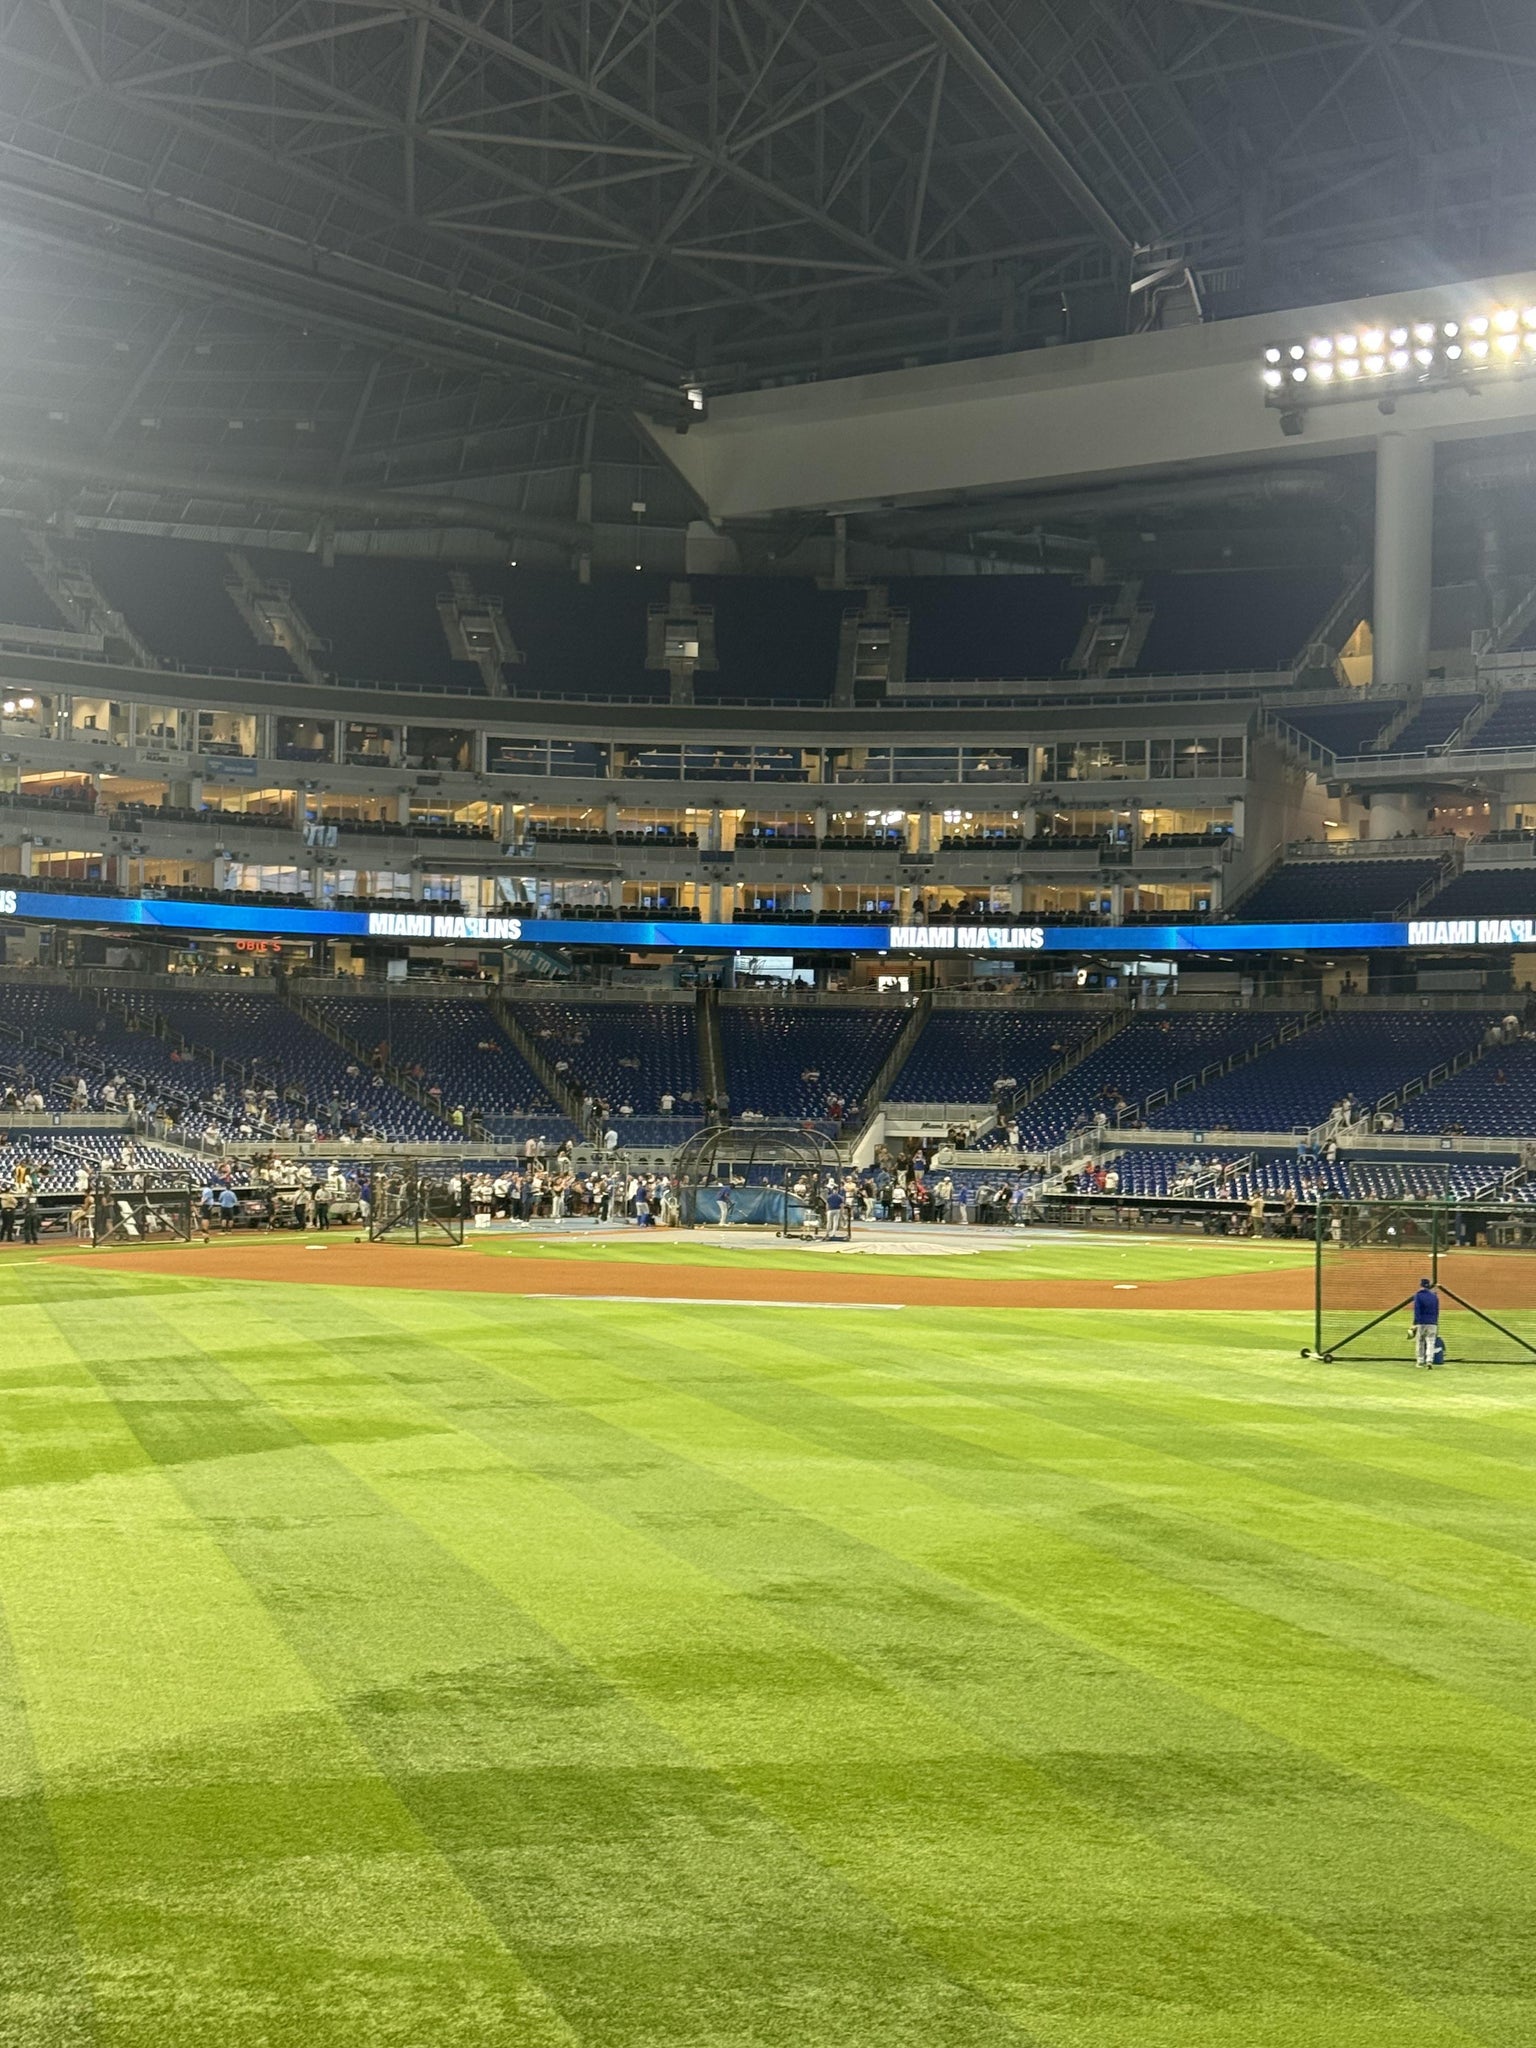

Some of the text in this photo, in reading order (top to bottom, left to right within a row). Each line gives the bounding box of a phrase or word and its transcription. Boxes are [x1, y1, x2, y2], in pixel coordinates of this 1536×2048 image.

[369, 913, 522, 939] MIAMI MARLINS
[890, 927, 1044, 948] MIAMI MARLINS
[1408, 921, 1476, 944] MIAMI
